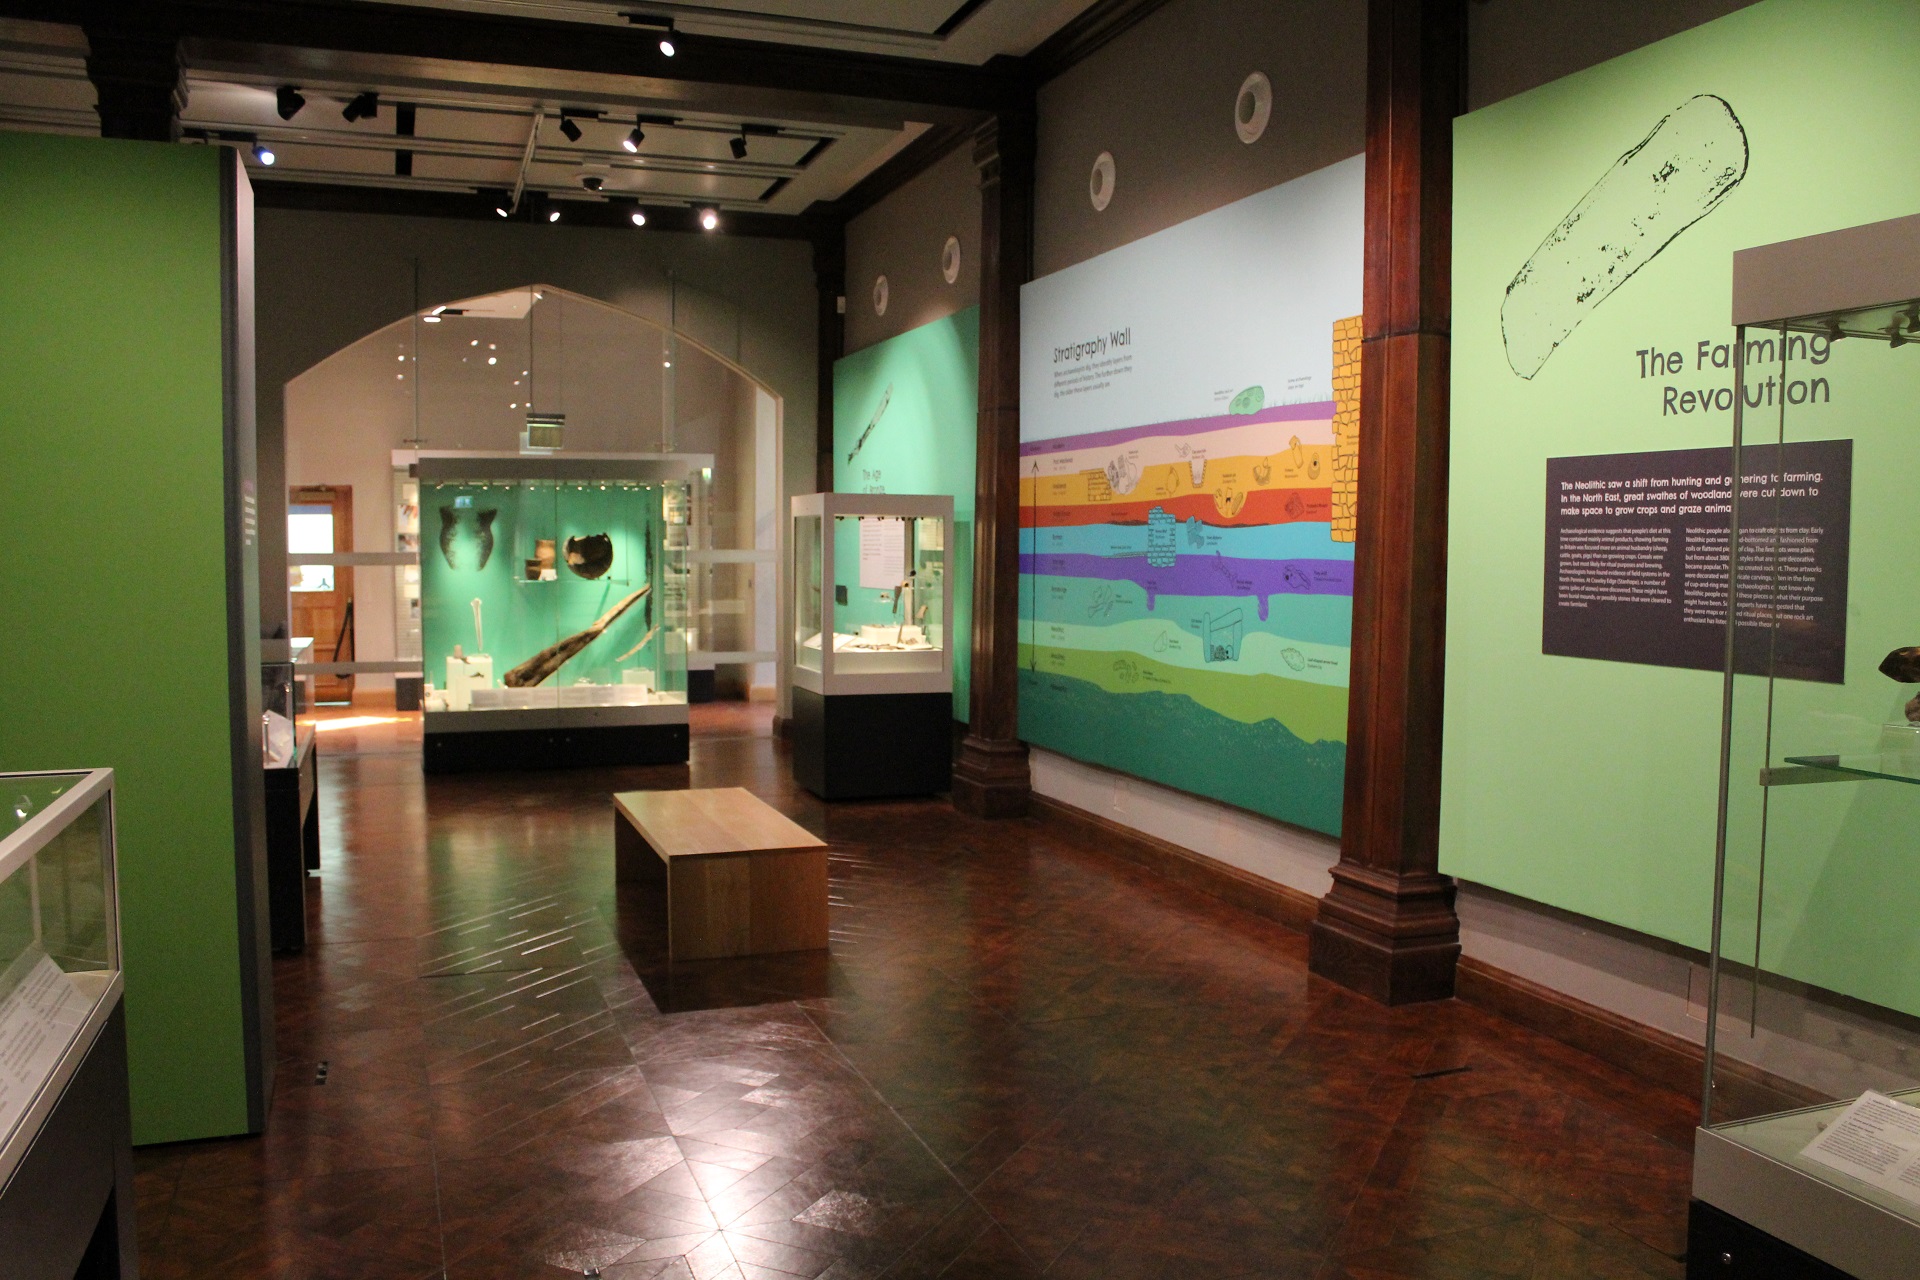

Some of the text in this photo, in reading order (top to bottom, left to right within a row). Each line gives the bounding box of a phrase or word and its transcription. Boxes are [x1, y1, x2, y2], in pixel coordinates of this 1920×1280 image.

[1054, 328, 1131, 363] Stratigraphy Wall
[1636, 347, 1683, 379] The
[1662, 374, 1831, 417] Revoution
[1561, 481, 1573, 491] The
[1575, 480, 1606, 490] Neolithic
[1608, 481, 1622, 489] saw
[1625, 480, 1631, 488] a
[1633, 477, 1648, 488] shift
[1651, 477, 1669, 488] from
[1672, 476, 1702, 488] hunting
[1705, 475, 1721, 485] and
[1784, 471, 1824, 484] farming.
[1561, 494, 1568, 503] In
[1570, 493, 1581, 502] the
[1583, 493, 1603, 502] North
[1605, 493, 1621, 503] East,
[1624, 492, 1644, 503] great
[1647, 490, 1677, 501] swathes
[1680, 490, 1689, 500] of
[1691, 489, 1732, 500] woodland
[1761, 488, 1776, 498] cut
[1809, 486, 1819, 496] to
[1561, 502, 1732, 517] make space to grow crops and graze anima
[1811, 527, 1824, 535] Early
